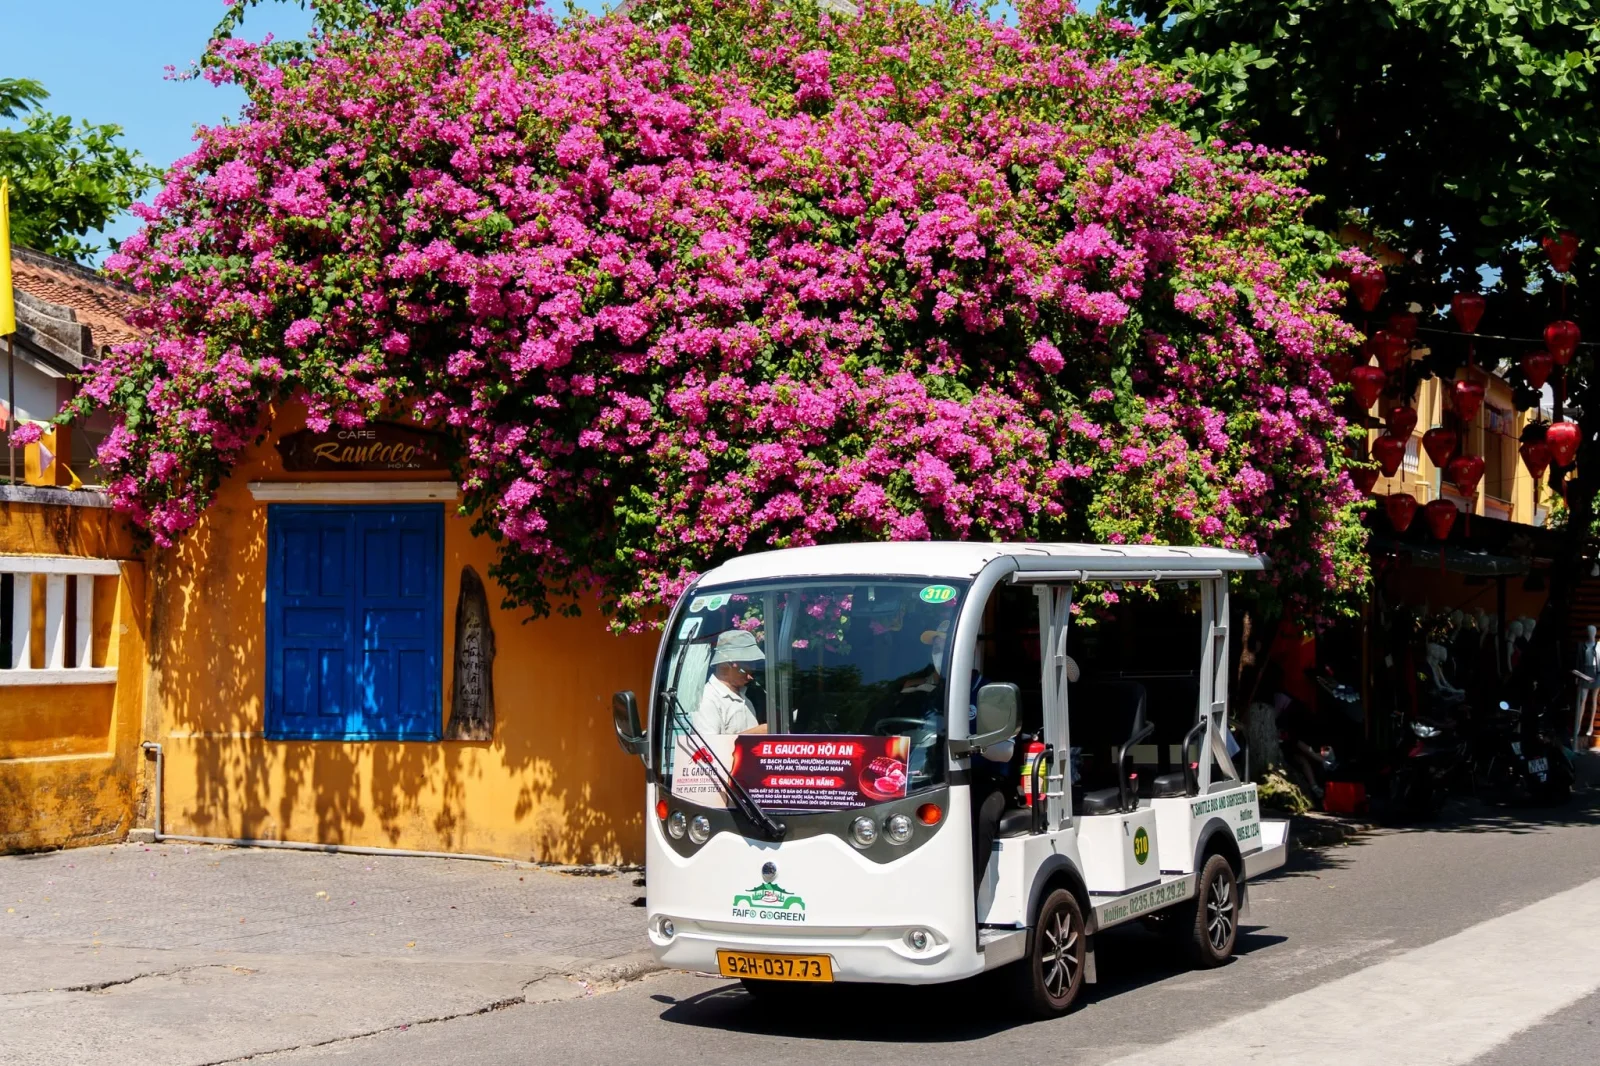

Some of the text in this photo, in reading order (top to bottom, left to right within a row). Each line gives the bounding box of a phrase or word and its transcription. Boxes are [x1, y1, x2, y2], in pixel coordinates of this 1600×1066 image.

[337, 430, 376, 439] CAFE
[925, 588, 950, 599] 310
[762, 742, 853, 757] EL GAUCHO HỘI AN
[682, 767, 689, 776] EL
[778, 778, 805, 786] GAUCHO
[1195, 800, 1210, 816] SHUTTLE
[1210, 797, 1218, 811] BUS
[1218, 795, 1226, 810] AND
[1247, 789, 1256, 802] TOUR
[1135, 836, 1148, 855] 310
[1103, 881, 1186, 923] Hotline: 0235.6.29.29.29
[732, 909, 805, 921] FAIFO GOGREEN
[727, 956, 822, 977] 92H-037.73
